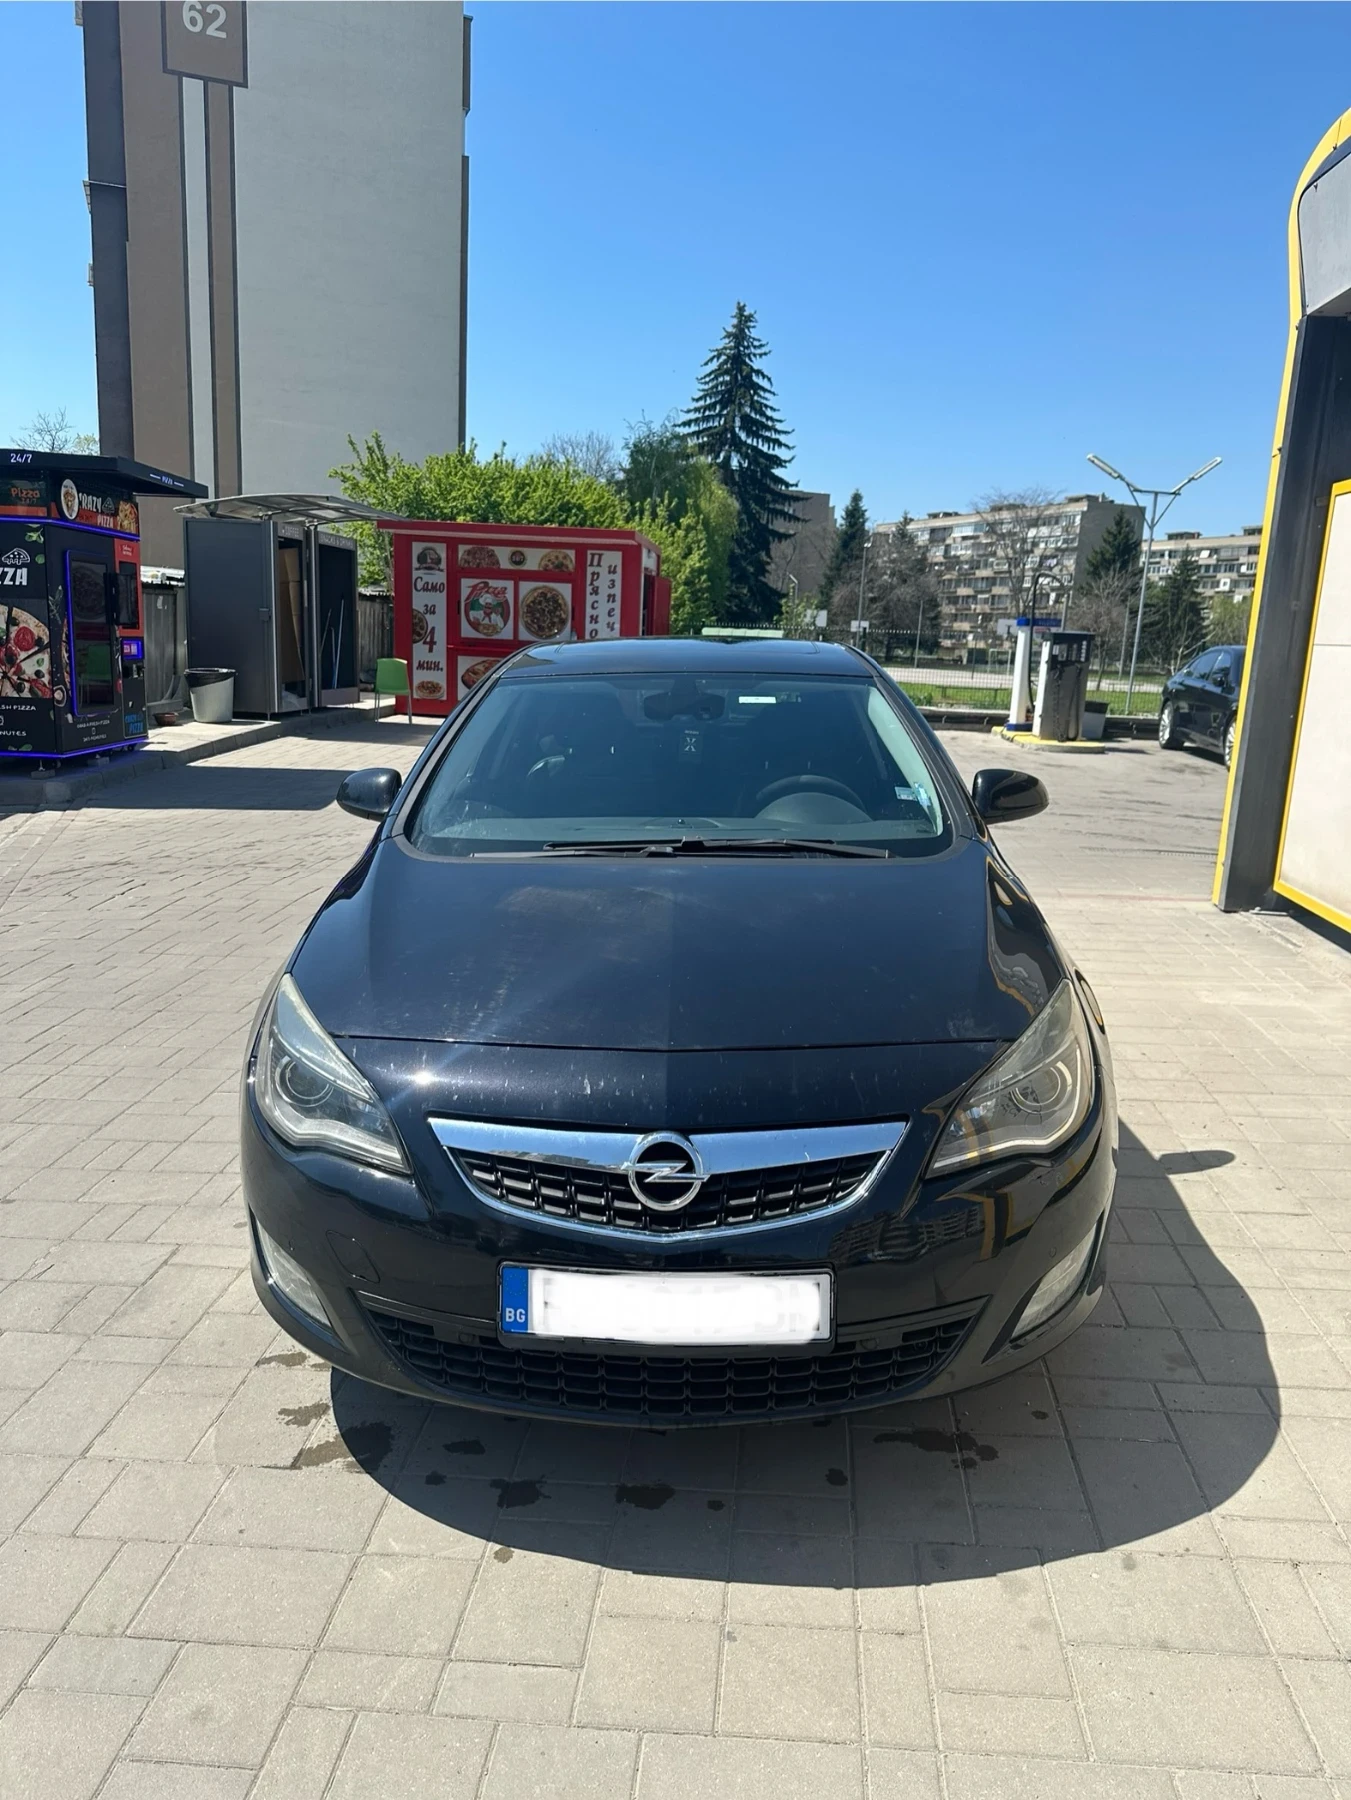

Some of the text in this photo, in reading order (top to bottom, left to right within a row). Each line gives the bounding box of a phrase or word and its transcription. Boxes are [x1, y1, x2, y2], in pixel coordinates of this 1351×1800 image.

[183, 0, 227, 38] 62
[10, 453, 32, 463] 24/7
[97, 514, 114, 528] PIZZA
[414, 576, 445, 593] Само
[588, 552, 604, 639] Прясно
[422, 603, 436, 615] за
[422, 626, 437, 653] 4
[416, 659, 444, 672] мин.
[506, 1307, 526, 1323] BG
